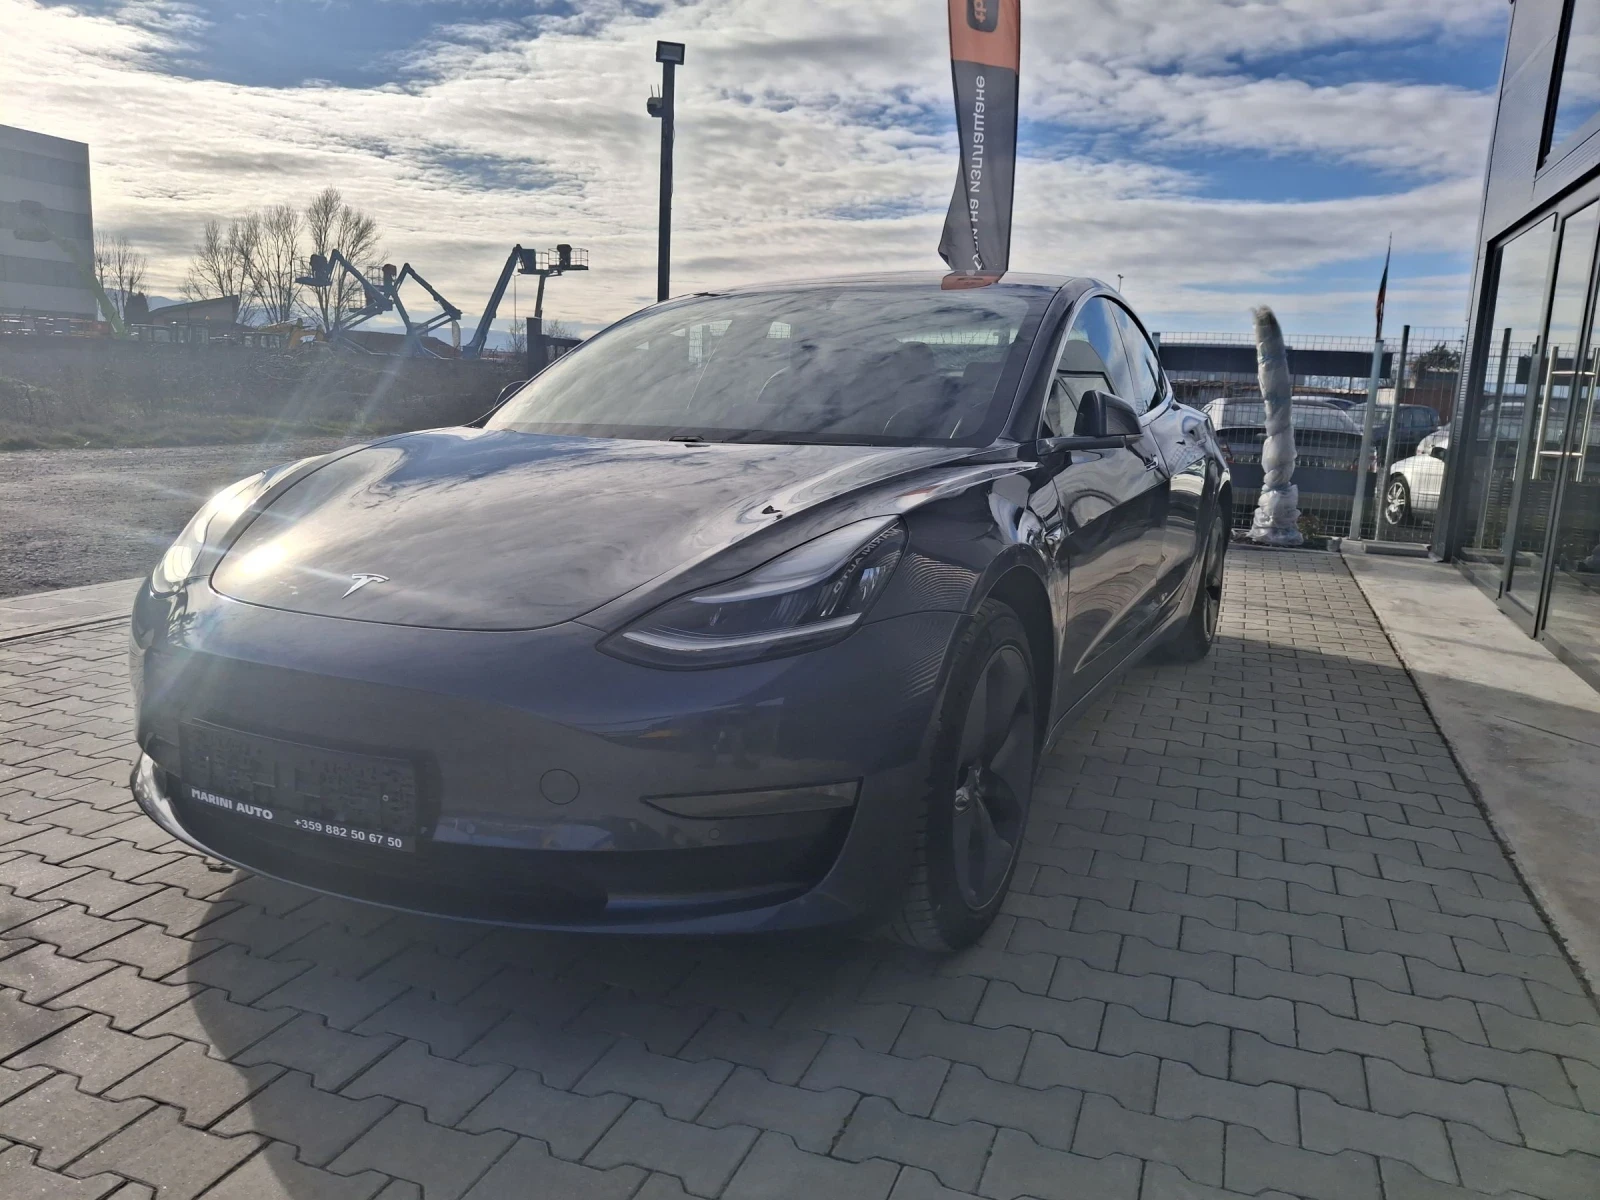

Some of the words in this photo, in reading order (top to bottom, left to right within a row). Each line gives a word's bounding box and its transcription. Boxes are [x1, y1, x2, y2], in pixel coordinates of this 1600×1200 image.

[191, 788, 232, 809] MARINI
[236, 802, 273, 820] AUTO
[294, 819, 322, 832] +359
[325, 825, 347, 838] 882
[351, 830, 365, 841] 50
[369, 833, 383, 844] 67
[387, 837, 402, 848] 50
